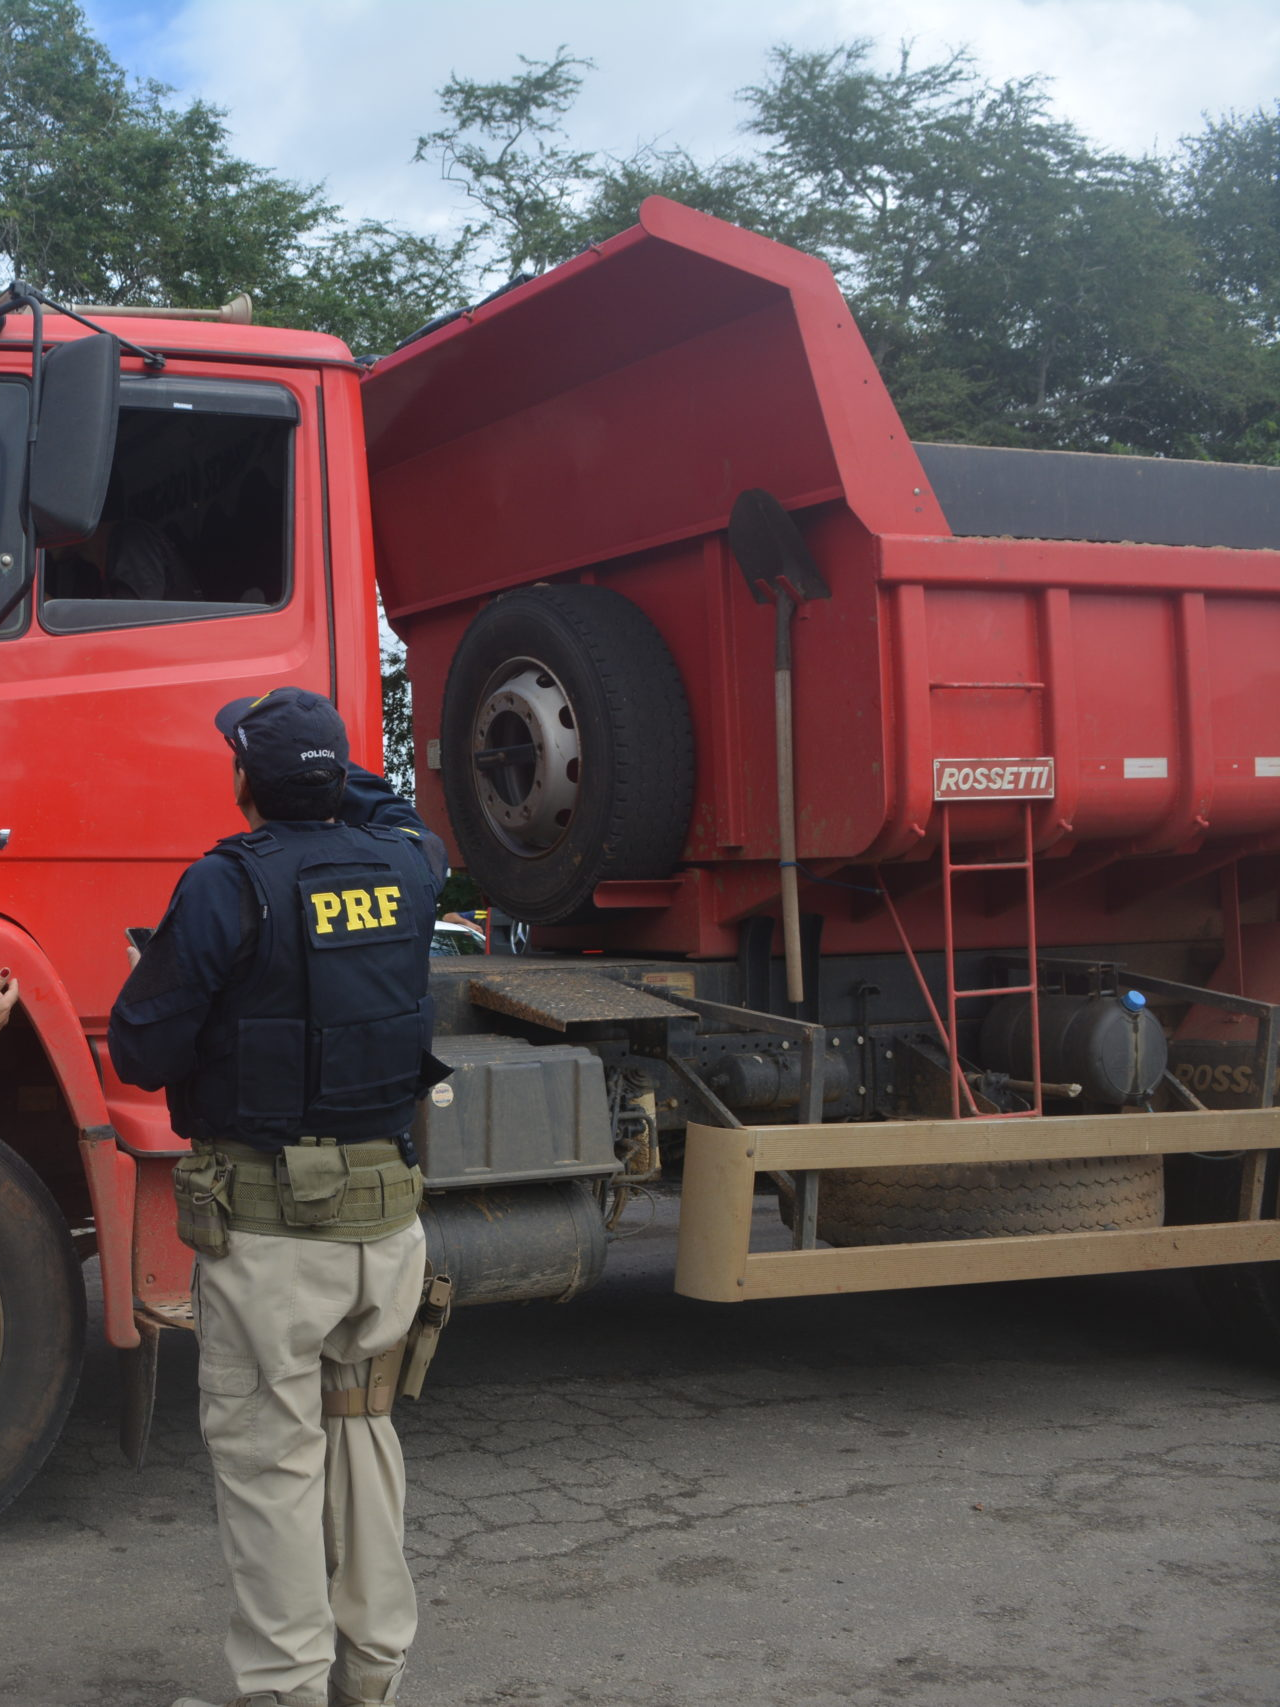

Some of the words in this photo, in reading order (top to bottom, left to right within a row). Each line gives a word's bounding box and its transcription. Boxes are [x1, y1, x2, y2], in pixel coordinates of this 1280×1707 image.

[300, 749, 336, 761] POLICIA
[940, 766, 1049, 790] ROSSETTI
[311, 886, 401, 934] PRF
[1174, 1063, 1280, 1096] ROSS
